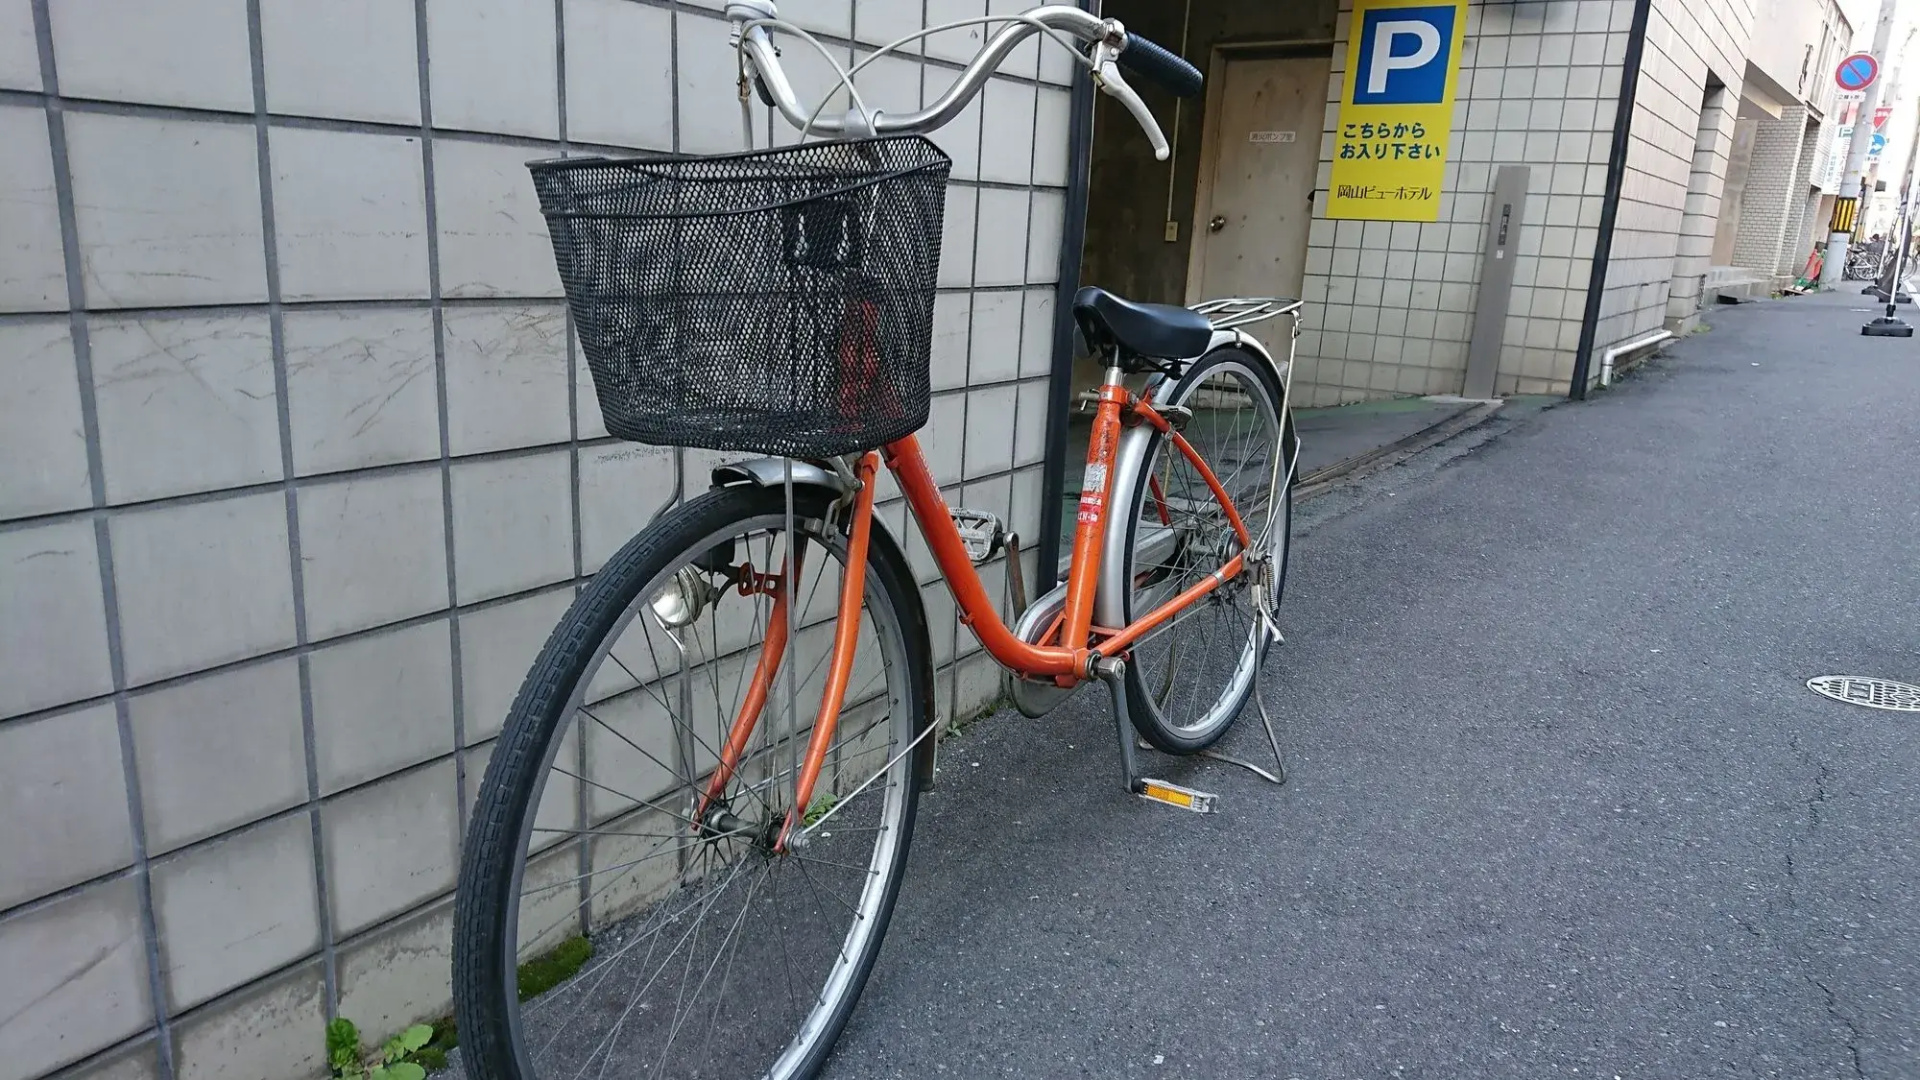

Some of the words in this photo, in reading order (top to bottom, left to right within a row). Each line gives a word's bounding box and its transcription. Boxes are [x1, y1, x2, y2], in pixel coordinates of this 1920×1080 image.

[1367, 20, 1441, 94] P
[1343, 122, 1425, 138] こちらから
[1339, 143, 1441, 160] お入り下さい
[1337, 184, 1433, 201] 岡山ビューホテル
